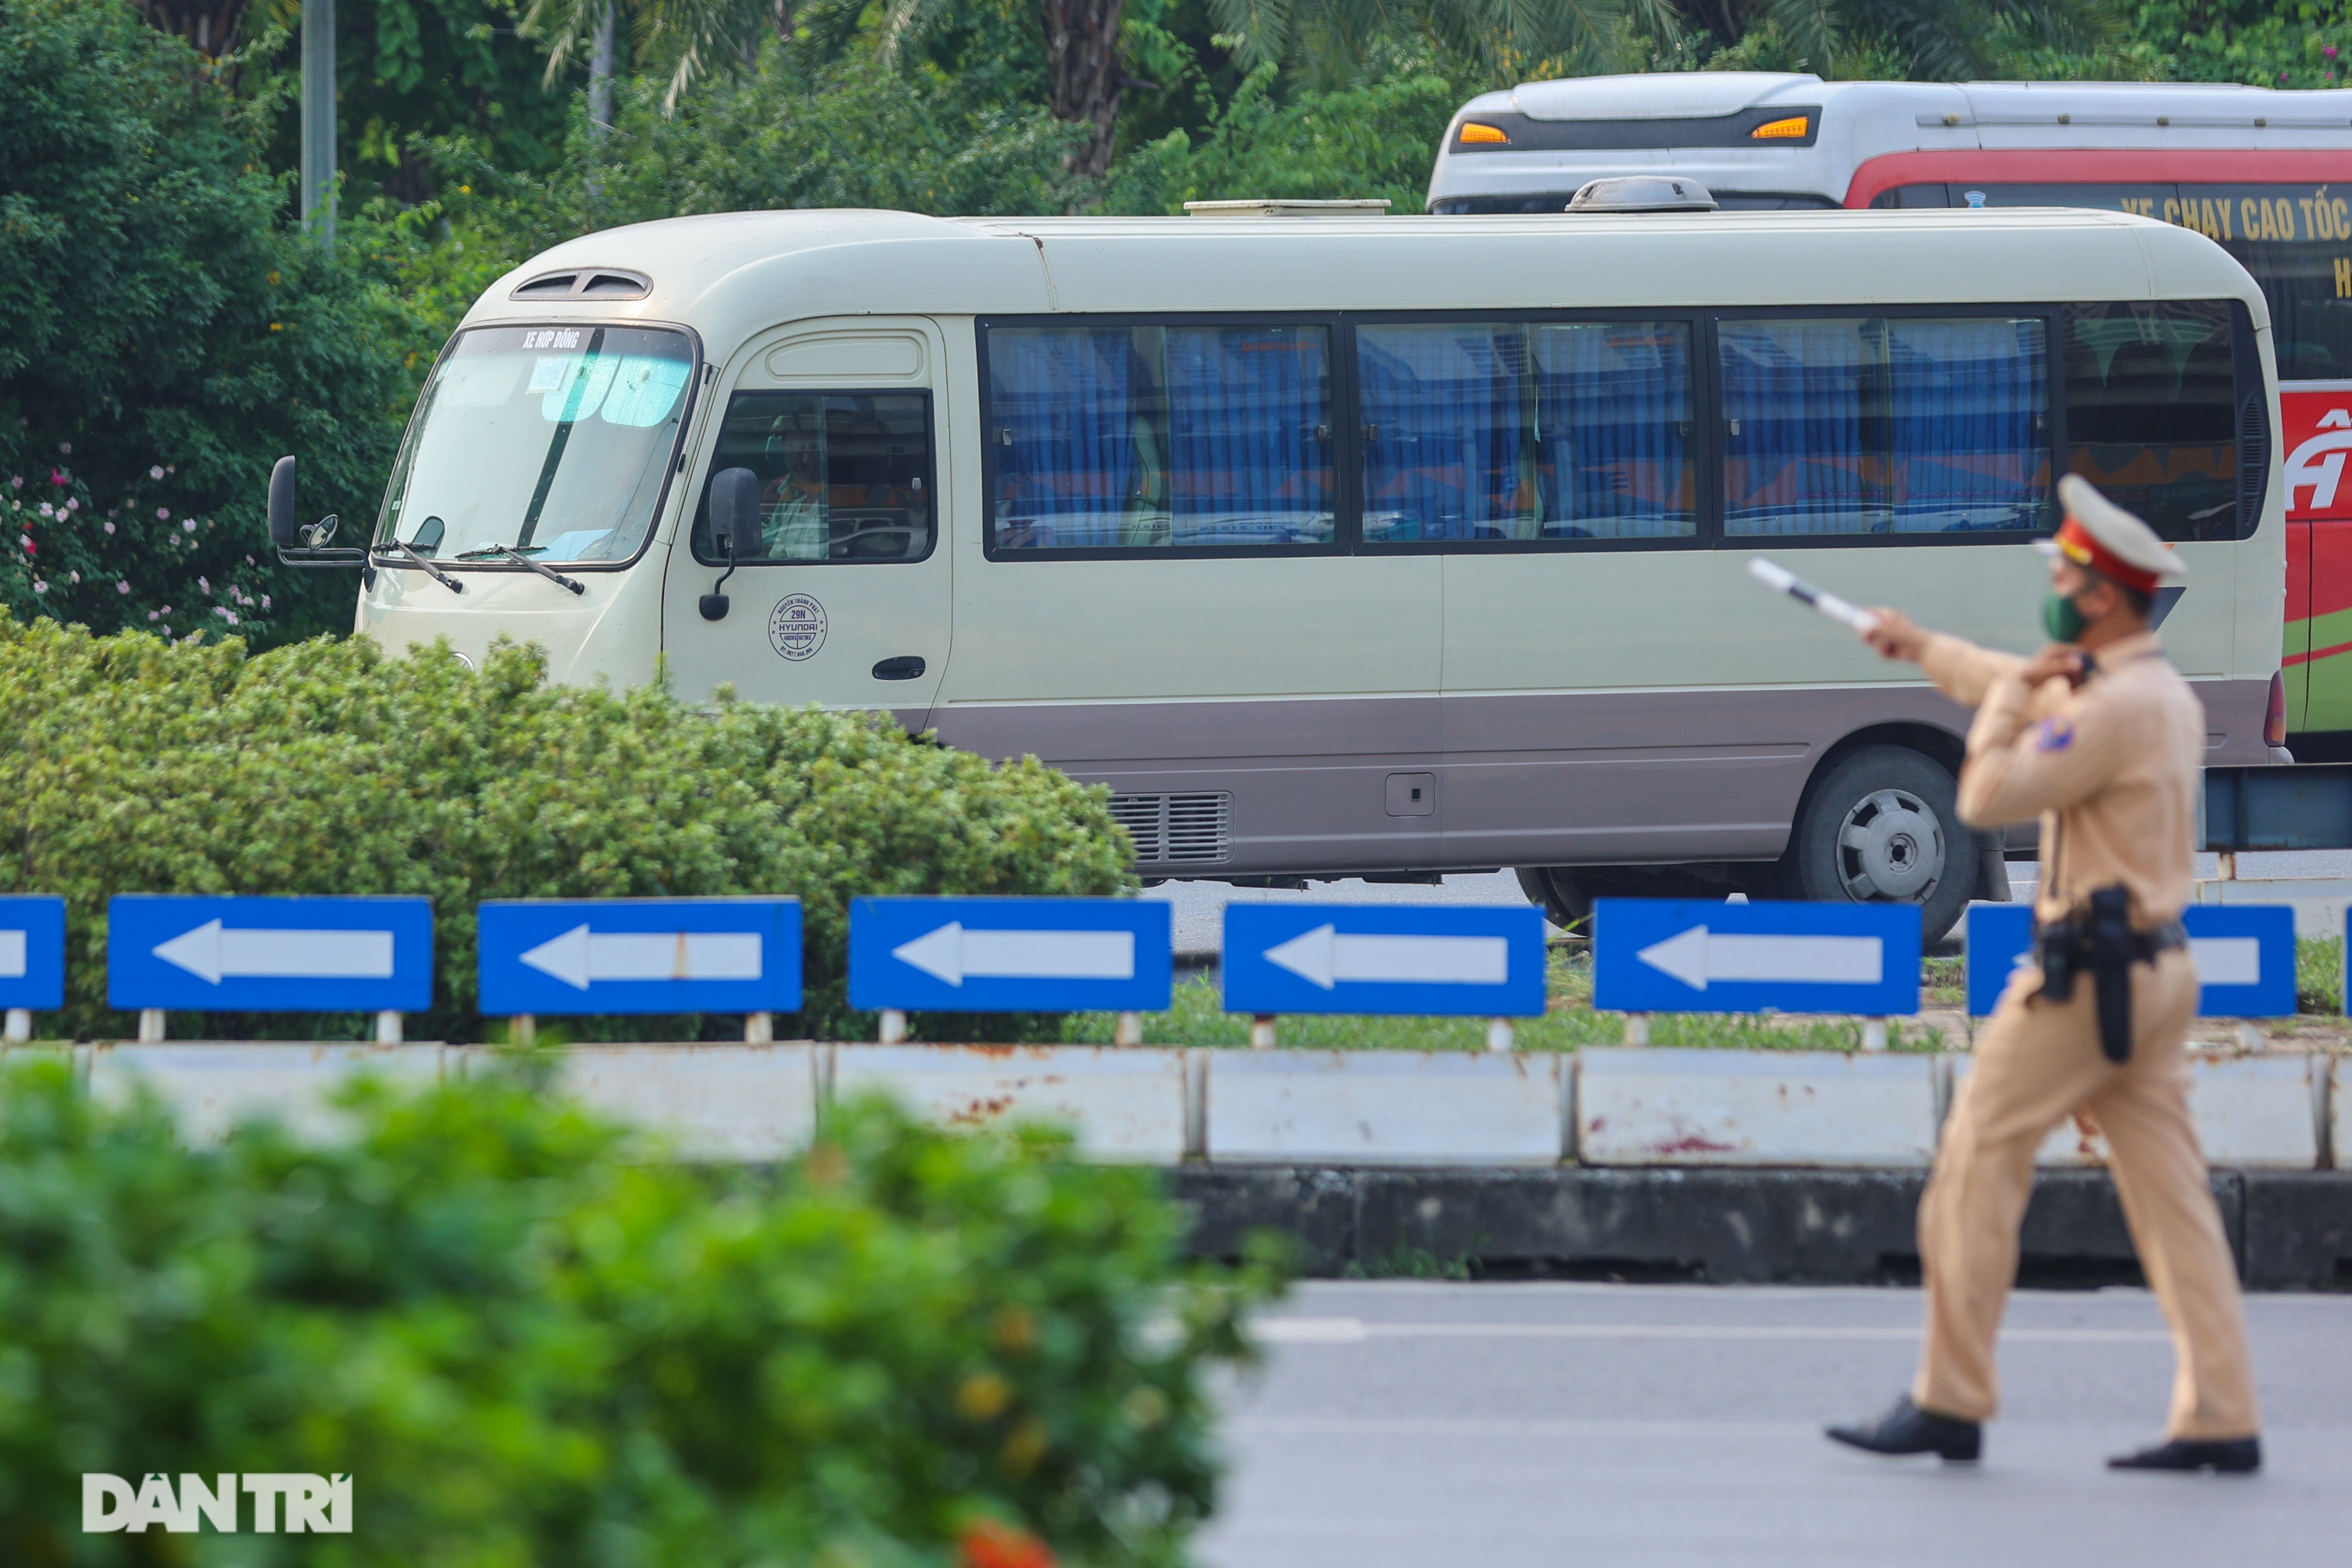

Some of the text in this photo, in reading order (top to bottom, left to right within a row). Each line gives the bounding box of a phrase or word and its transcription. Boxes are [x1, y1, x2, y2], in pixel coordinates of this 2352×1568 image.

[2241, 197, 2296, 242] CAO
[2299, 184, 2351, 242] TỐC
[522, 331, 537, 349] XE
[791, 609, 805, 619] 29N
